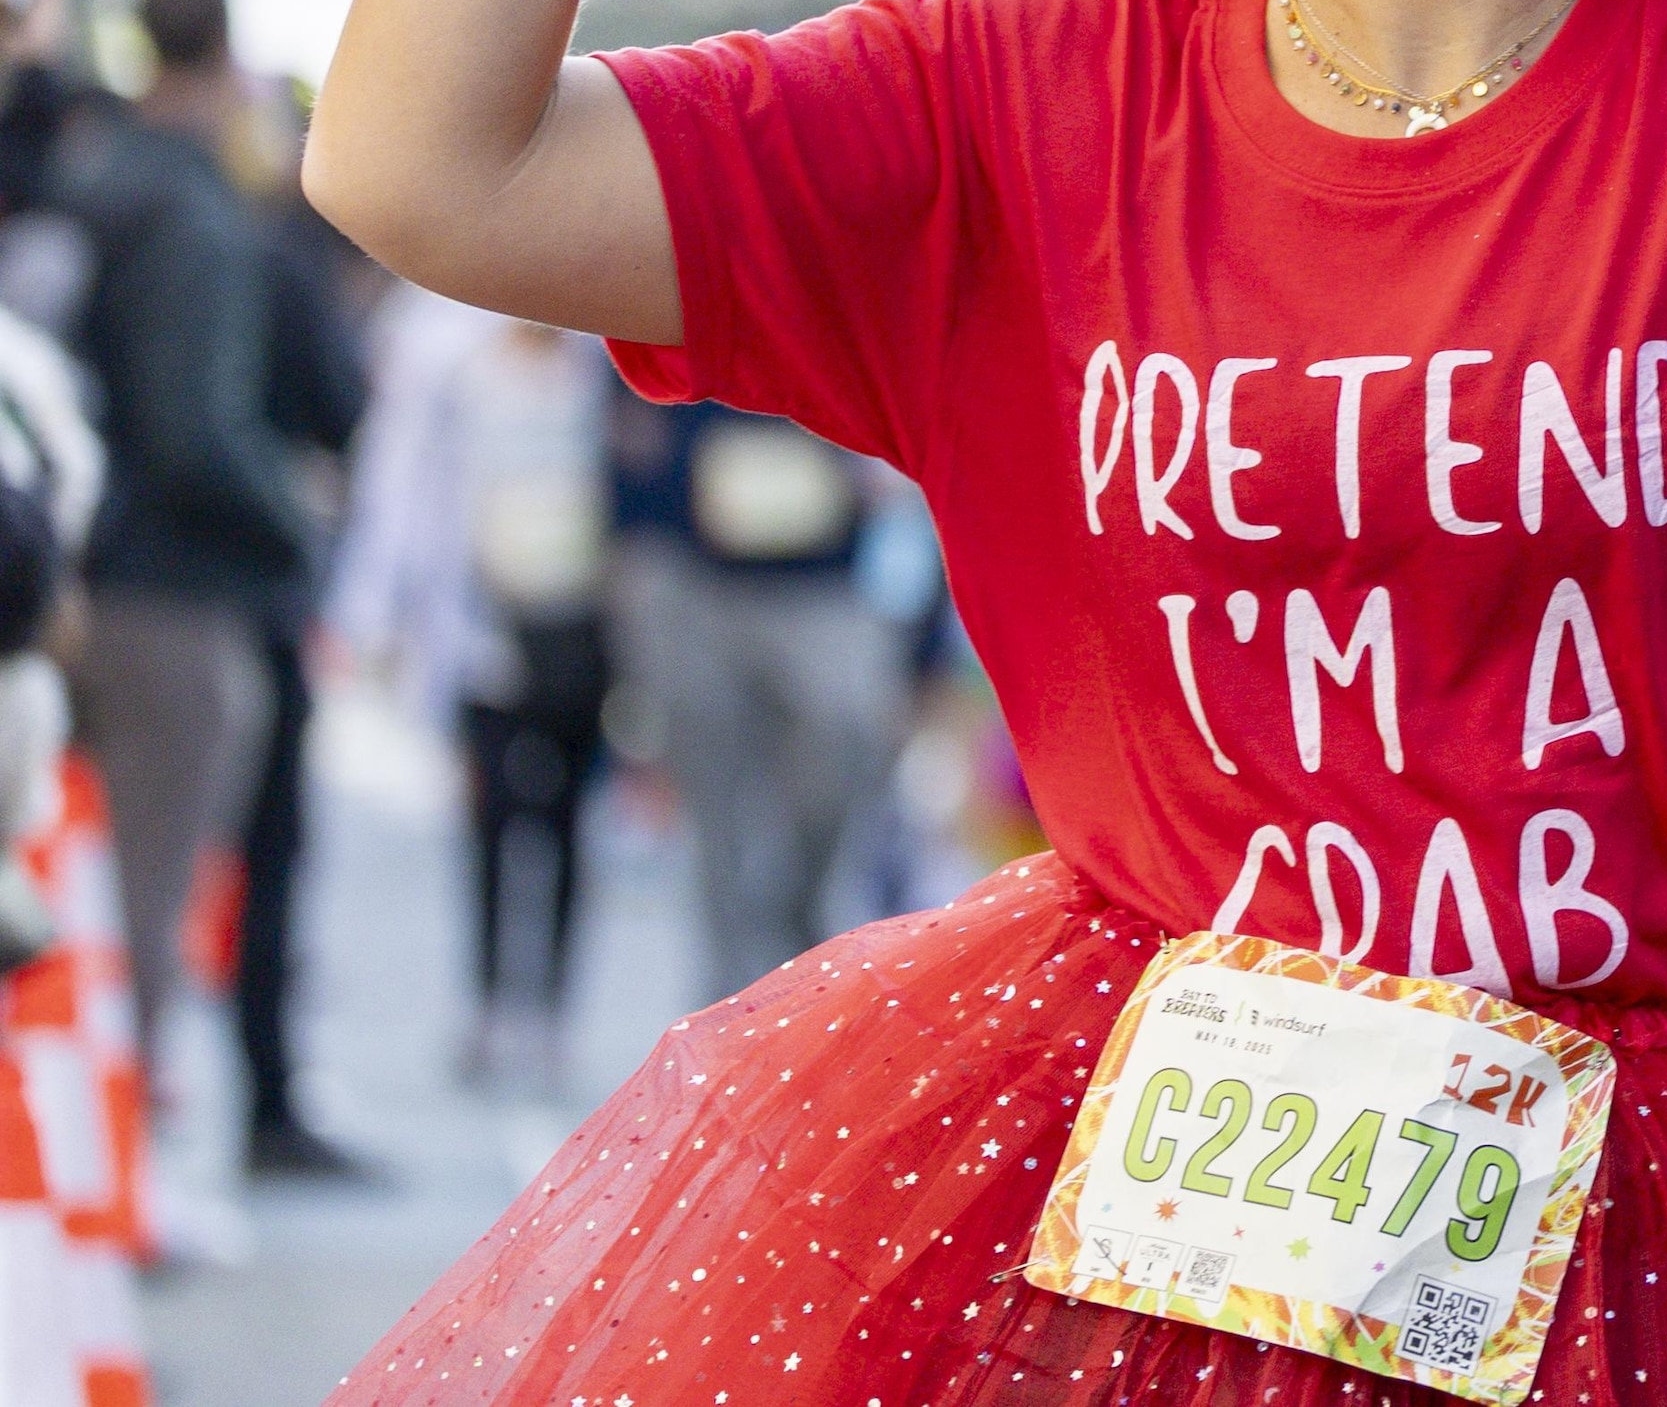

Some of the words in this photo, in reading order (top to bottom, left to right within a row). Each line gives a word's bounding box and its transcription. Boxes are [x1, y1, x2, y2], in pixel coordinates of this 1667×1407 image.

[1157, 585, 1404, 775] I'M
[1522, 577, 1626, 771] A
[1263, 1012, 1328, 1038] windsurf
[1443, 1053, 1549, 1129] 12K
[1123, 1067, 1522, 1263] C22479
